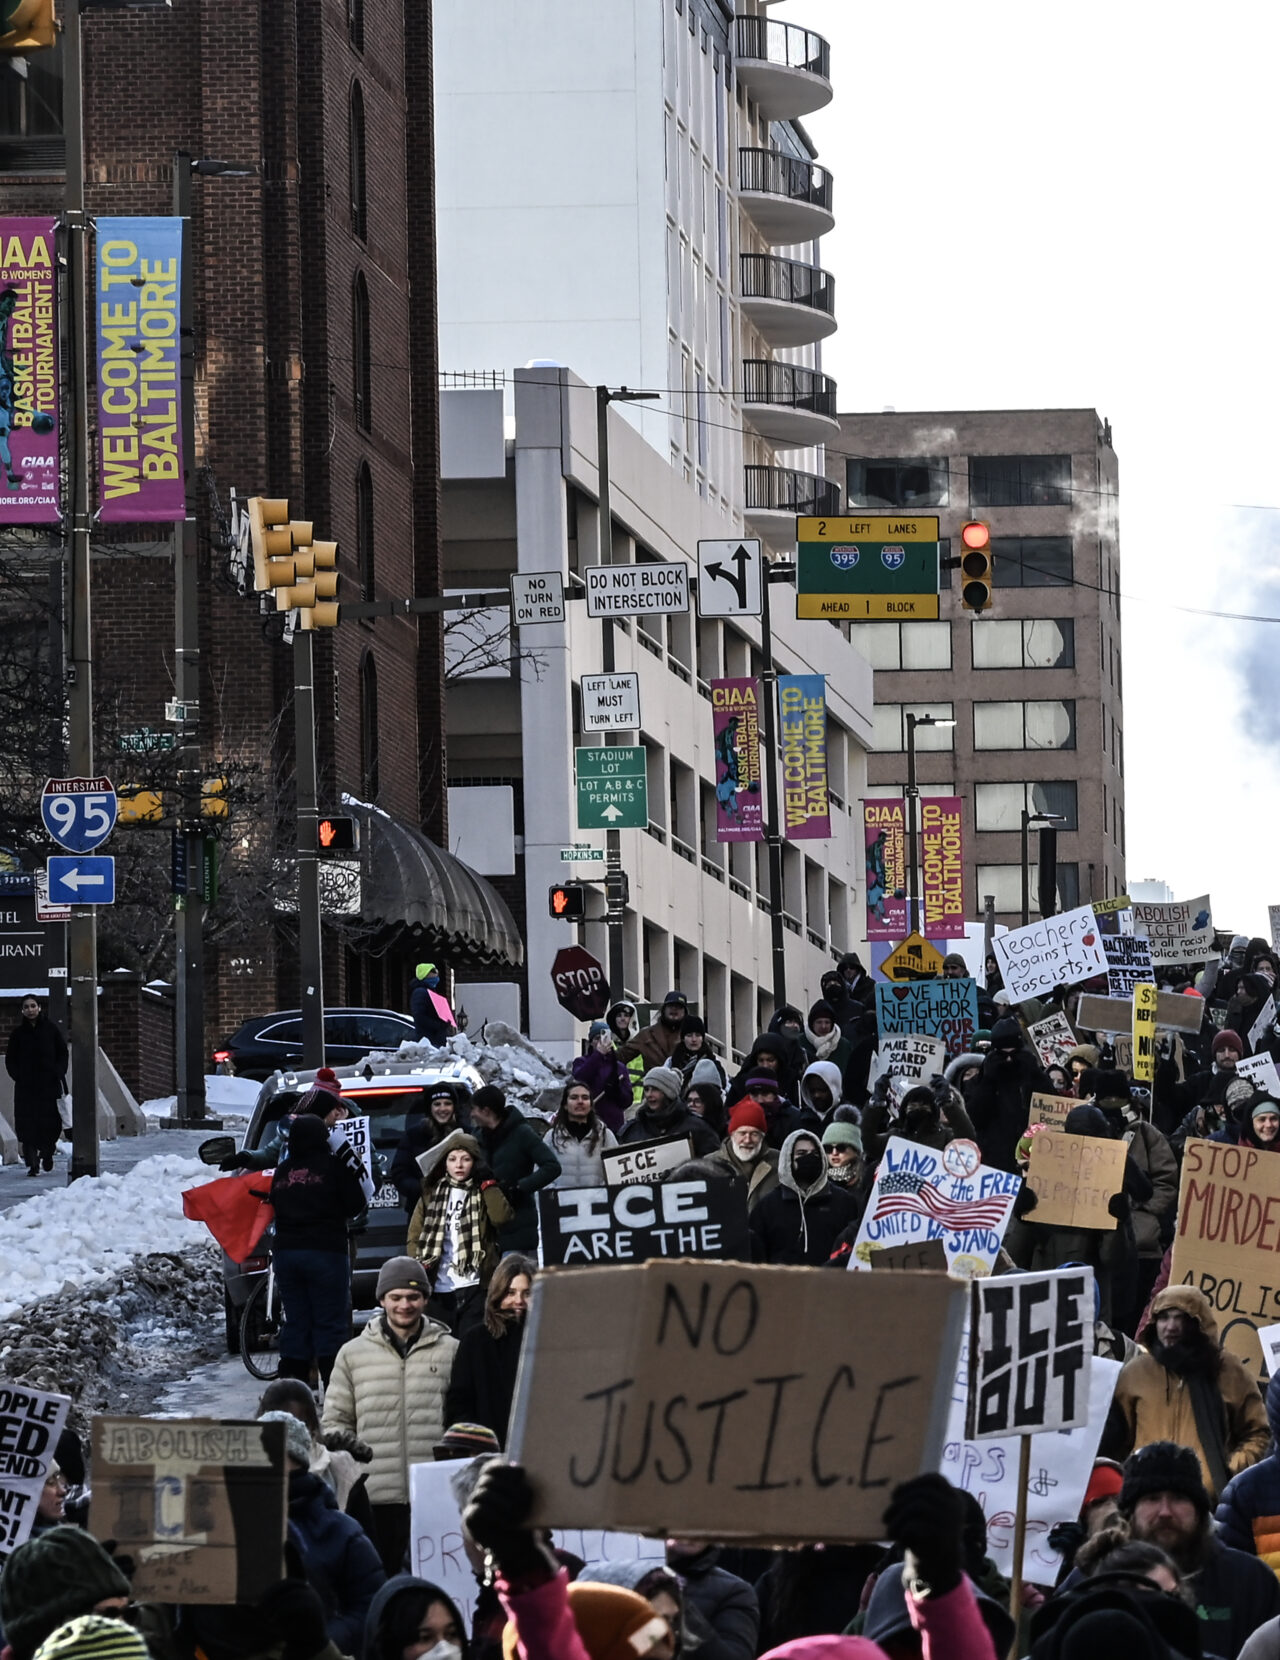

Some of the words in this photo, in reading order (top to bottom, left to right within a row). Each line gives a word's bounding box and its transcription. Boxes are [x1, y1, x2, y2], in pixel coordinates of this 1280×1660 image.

[101, 240, 138, 291] TO
[14, 282, 33, 427] BASKETBALL
[35, 281, 54, 412] TOURNAMENT
[140, 258, 179, 480] BALTIMORE
[102, 301, 140, 499] WELCOME
[21, 456, 55, 467] CIAA
[818, 521, 826, 535] 2
[850, 524, 870, 534] LEFT
[888, 524, 917, 534] LANES
[835, 554, 855, 564] 395
[885, 554, 900, 564] 95
[528, 579, 546, 589] NO
[590, 574, 607, 589] DO
[613, 572, 636, 588] NOT
[641, 570, 683, 585] BLOCK
[524, 593, 553, 603] TURN
[594, 591, 682, 610] INTERSECTION
[821, 602, 849, 612] AHEAD
[866, 600, 870, 614] 1
[887, 602, 915, 612] BLOCK
[518, 608, 533, 618] ON
[540, 607, 561, 617] RED
[587, 681, 606, 691] LEFT
[611, 679, 632, 690] LANE
[597, 695, 623, 707] MUST
[712, 687, 756, 706] CIAA
[782, 687, 802, 716] TO
[590, 715, 610, 724] TURN
[615, 713, 633, 723] LEFT
[587, 751, 634, 761] STADIUM
[804, 697, 828, 817] BALTIMORE
[601, 764, 619, 773] LOT
[784, 721, 807, 827] WELCOME
[52, 781, 106, 792] INTERSTATE
[580, 781, 599, 791] LOT
[636, 780, 643, 790] C
[589, 793, 635, 803] PERMITS
[49, 796, 112, 838] 95
[865, 807, 903, 822] CIAA
[923, 805, 941, 830] TO
[563, 851, 593, 861] HOPKINS
[942, 813, 962, 915] BALTIMORE
[925, 832, 943, 923] WELCOME
[1134, 905, 1190, 921] ABOLISH
[993, 915, 1089, 960] Teachers
[1007, 942, 1072, 978] Against
[556, 967, 601, 997] STOP
[1109, 969, 1152, 978] STOP
[937, 982, 971, 999] THY
[882, 1000, 973, 1019] NEIGHBOR
[883, 1021, 926, 1034] WITH
[931, 1018, 975, 1037] YOUR
[883, 1040, 908, 1052] MAKE
[913, 1042, 935, 1055] ICE
[889, 1053, 927, 1065] SCARED
[1251, 1058, 1270, 1069] WILL
[887, 1065, 921, 1078] AGAIN
[945, 1149, 974, 1169] ICE
[1038, 1137, 1121, 1164] DEPORT
[617, 1149, 657, 1178] ICE
[886, 1148, 937, 1179] LAND
[1188, 1143, 1257, 1181] STOP
[931, 1173, 950, 1188] of
[951, 1177, 974, 1200] the
[980, 1171, 1022, 1200] FREE
[557, 1180, 709, 1233] ICE
[866, 1211, 921, 1240] UNITED
[927, 1219, 950, 1240] WE
[564, 1231, 633, 1260] ARE
[650, 1224, 722, 1255] THE
[949, 1228, 1000, 1255] STAND
[657, 1279, 759, 1356] NO
[982, 1276, 1085, 1380] ICE
[977, 1344, 1084, 1435] OUT
[109, 1427, 249, 1463] ABOLISH
[110, 1475, 216, 1538] ICE
